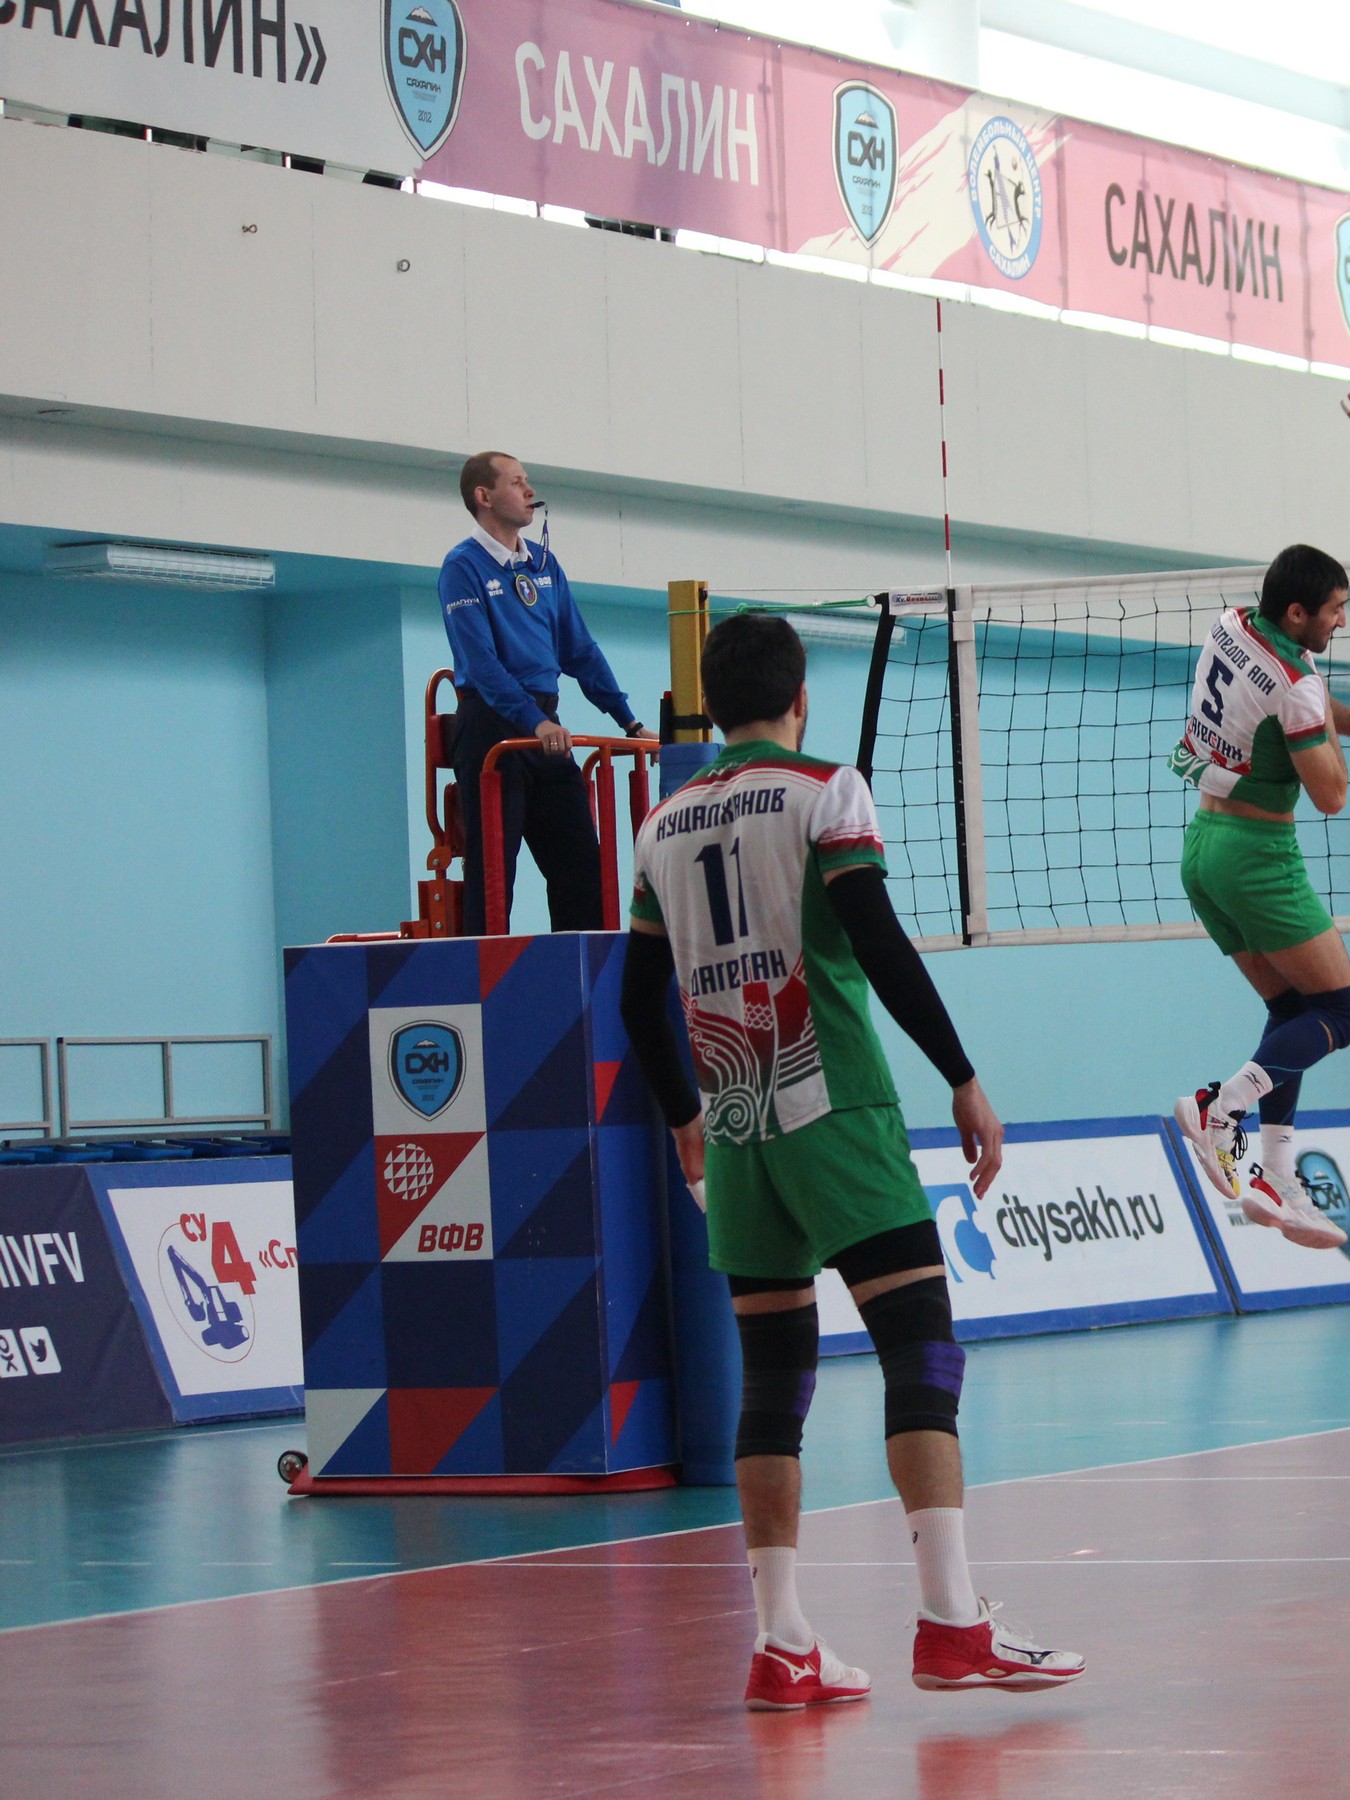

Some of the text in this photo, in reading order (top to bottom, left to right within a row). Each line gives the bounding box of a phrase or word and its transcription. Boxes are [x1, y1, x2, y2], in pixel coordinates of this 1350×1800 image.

[406, 77, 442, 93] САХАЛИН
[418, 109, 433, 124] 2012
[514, 41, 759, 186] САХАЛИН
[1105, 182, 1284, 303] САХАЛИН
[1201, 654, 1234, 728] 5
[657, 787, 786, 842] НУЦАЛХАНОВ
[694, 836, 749, 946] 11
[211, 1221, 258, 1295] 4
[417, 1223, 485, 1252] ВФВ
[996, 1185, 1165, 1262] citysakh.ru
